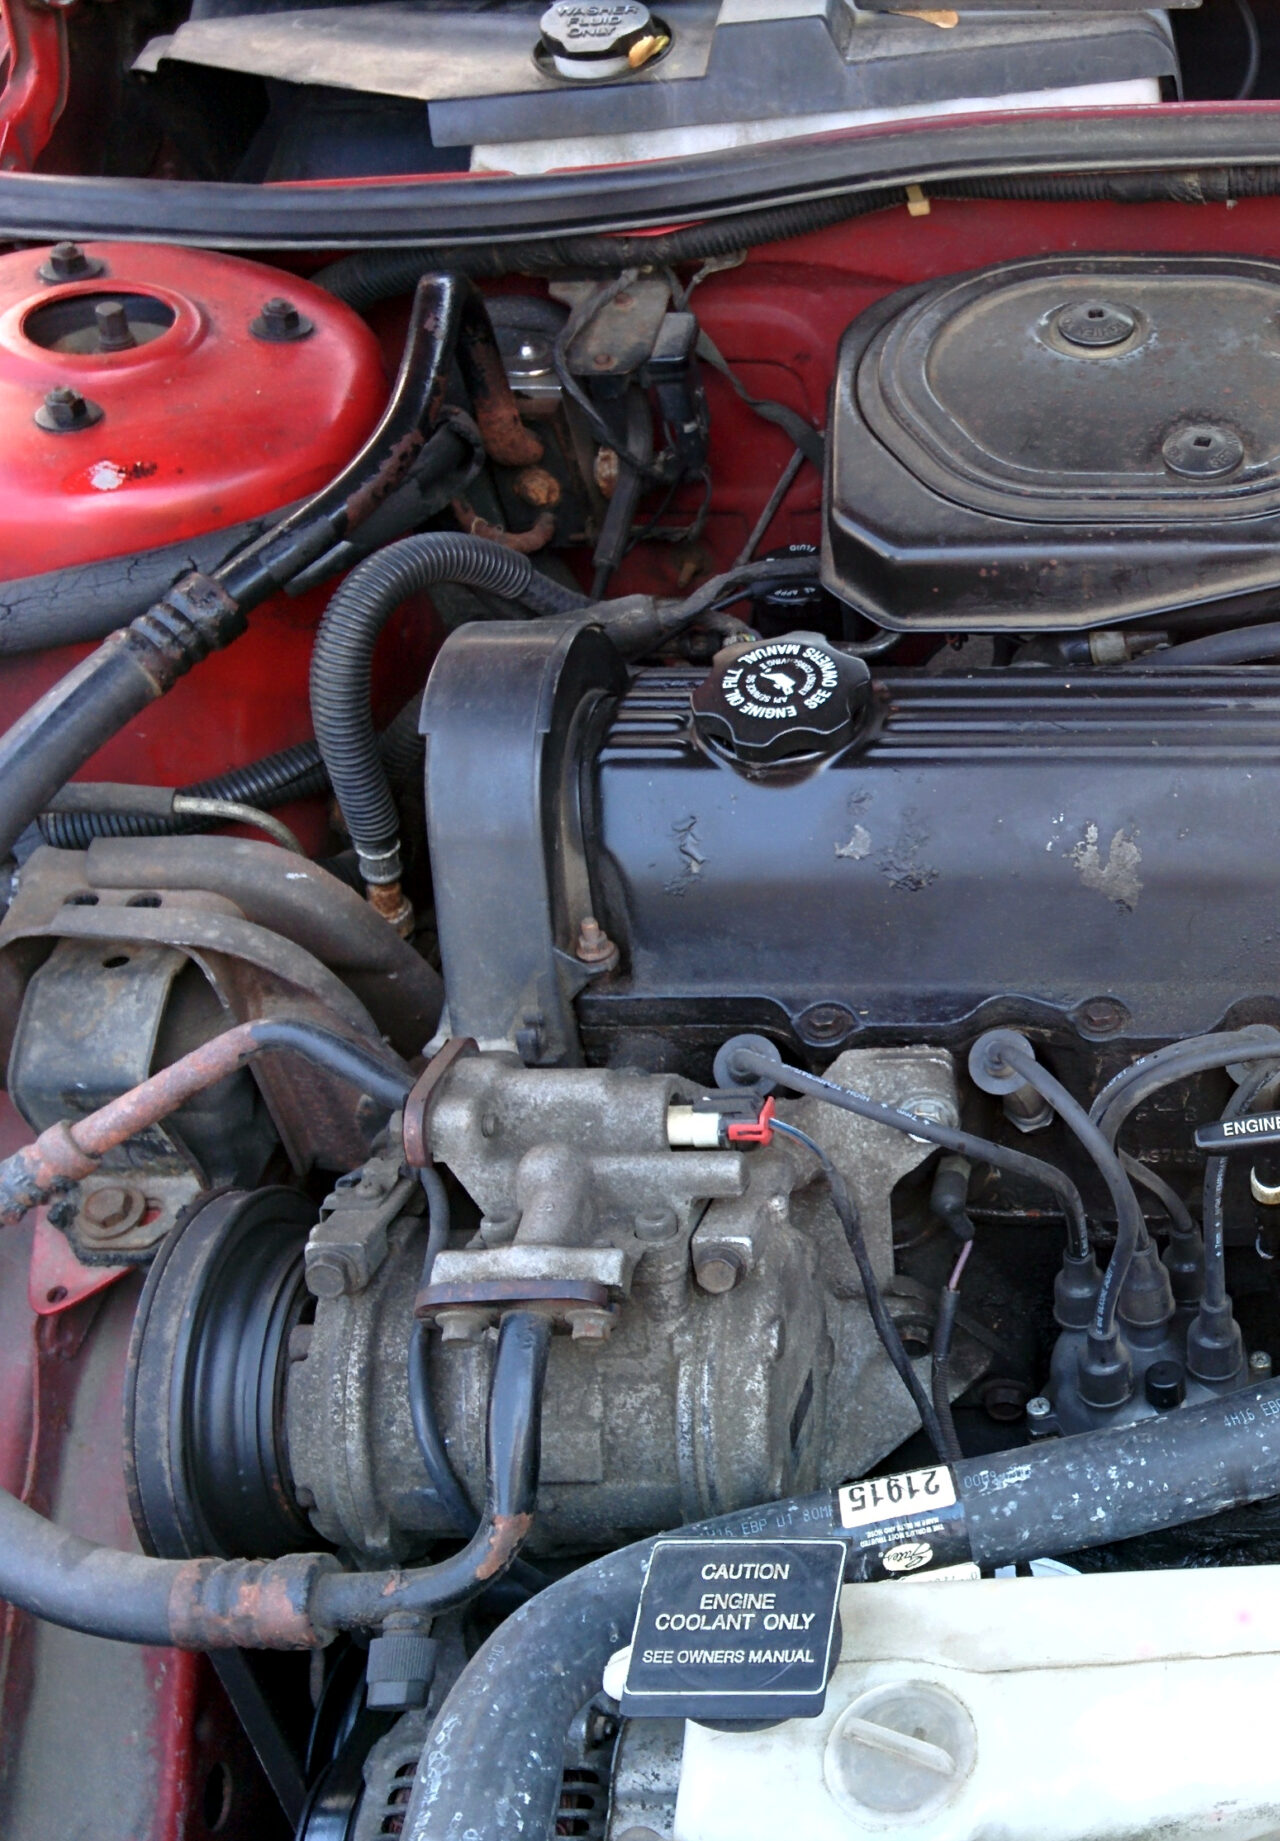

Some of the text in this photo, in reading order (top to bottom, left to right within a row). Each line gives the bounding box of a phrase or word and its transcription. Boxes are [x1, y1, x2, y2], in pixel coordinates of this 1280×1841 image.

[557, 5, 640, 16] WASHER
[566, 16, 623, 27] FLUID
[566, 27, 616, 39] ONLY
[737, 644, 838, 710] SEE OWNERS MANUAL
[721, 668, 798, 720] ENGINE OIL FILL
[773, 695, 788, 704] API
[846, 1088, 870, 1103] HIGH
[896, 1107, 918, 1122] 7mm
[849, 1470, 941, 1512] 21915
[741, 1519, 769, 1536] EBP
[860, 1536, 887, 1547] TRUSTED
[701, 1563, 790, 1580] CAUTION
[700, 1593, 776, 1610] ENGINE
[655, 1613, 815, 1631] COOLANT ONLY
[642, 1650, 814, 1664] SEE OWNERS MANUAL
